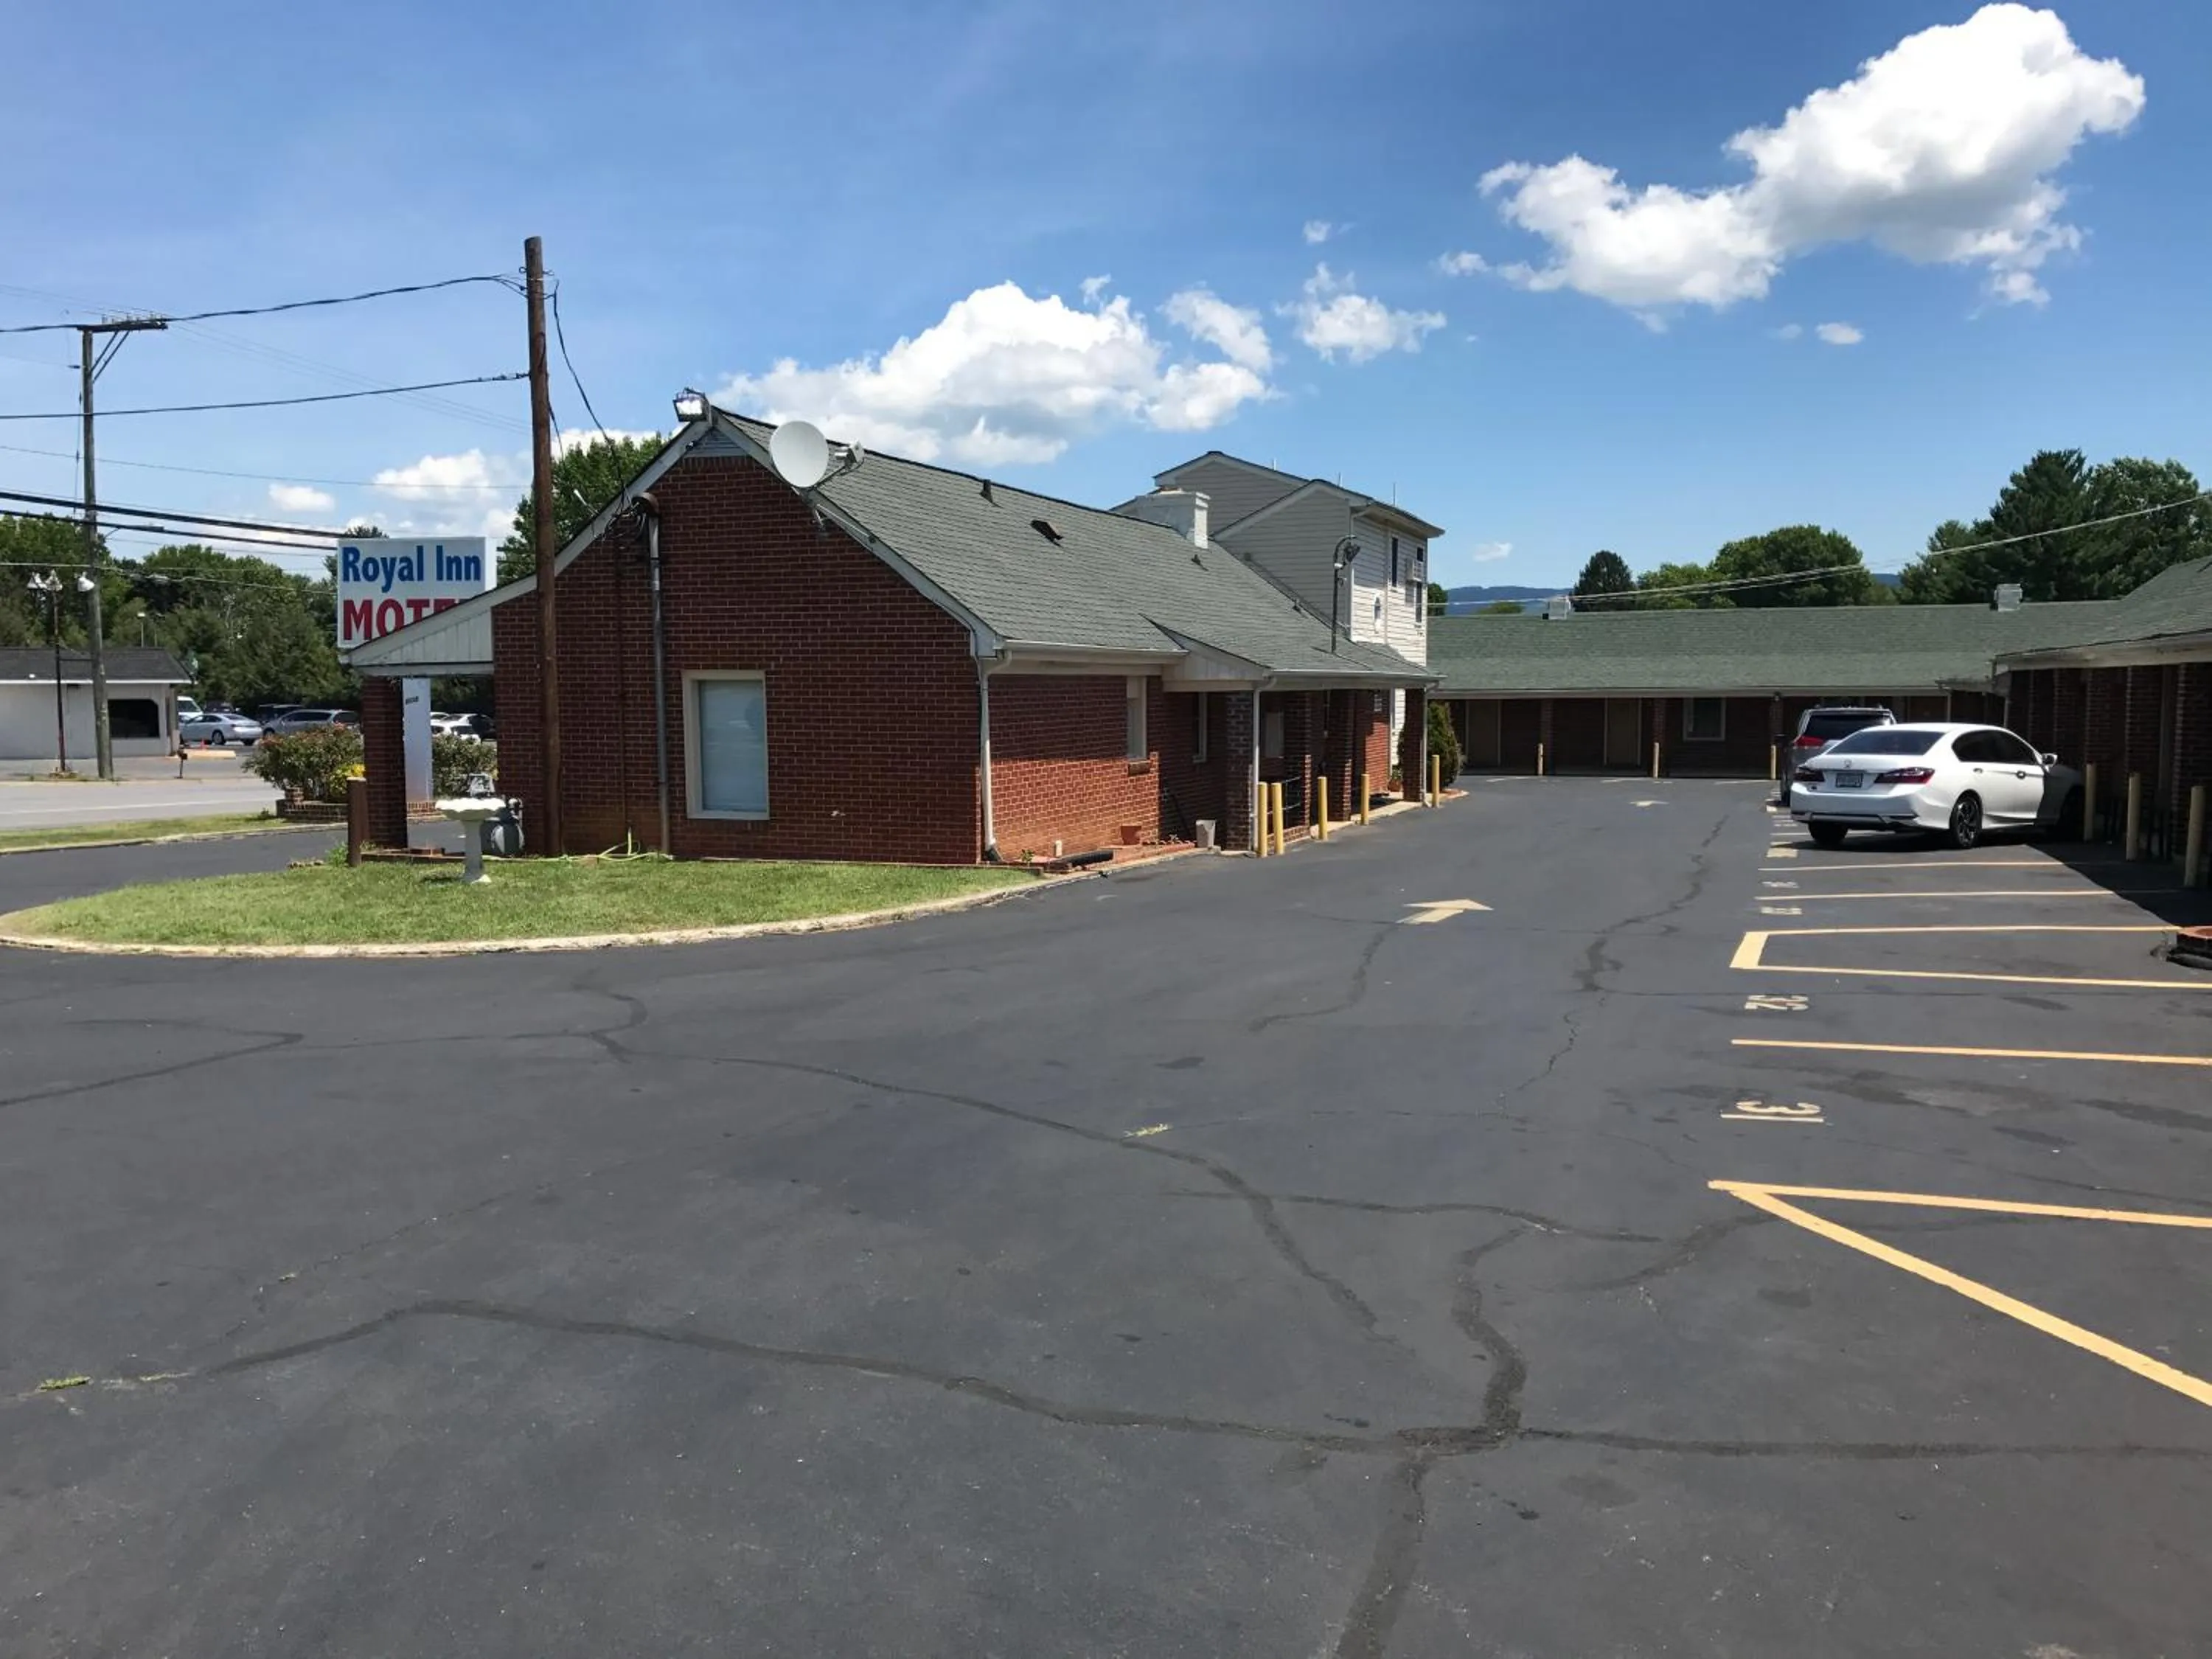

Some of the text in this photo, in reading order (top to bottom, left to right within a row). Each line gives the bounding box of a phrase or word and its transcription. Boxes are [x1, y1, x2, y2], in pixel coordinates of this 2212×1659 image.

[341, 545, 481, 593] Royal Inn
[343, 598, 470, 641] MOT
[1720, 1100, 1824, 1123] 31
